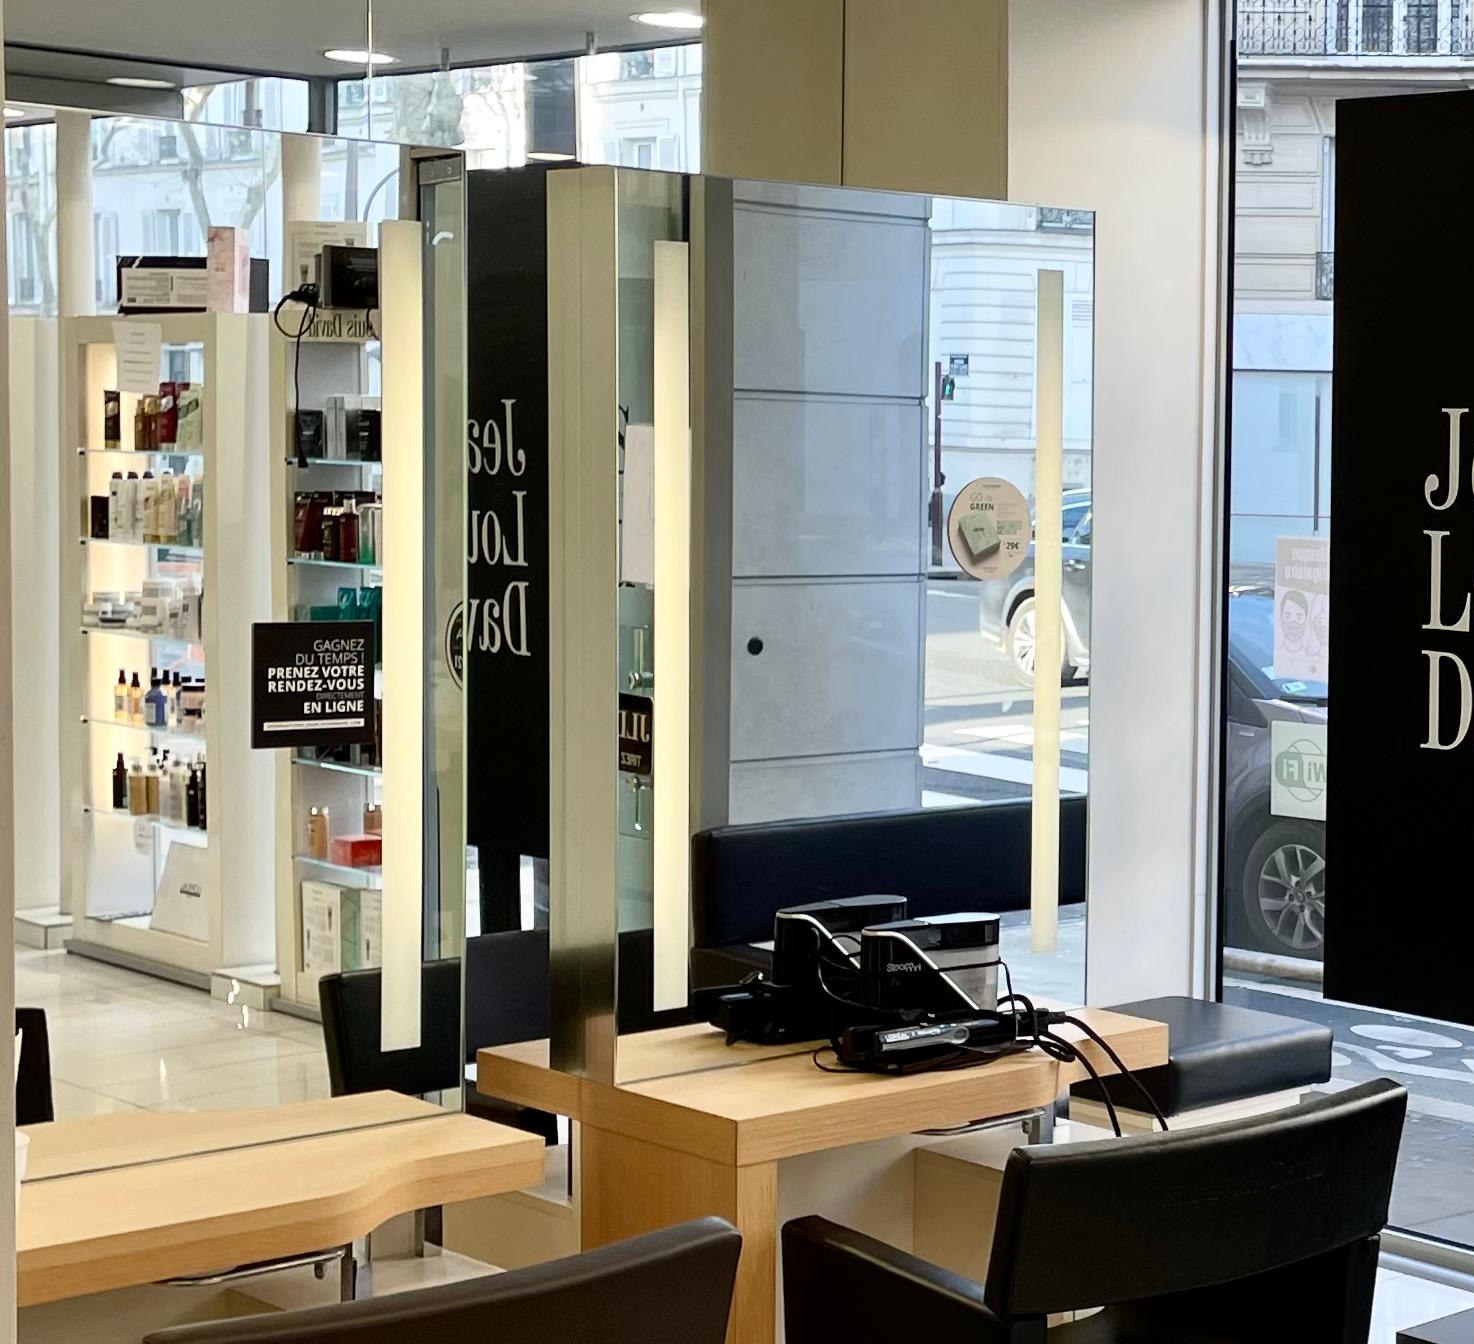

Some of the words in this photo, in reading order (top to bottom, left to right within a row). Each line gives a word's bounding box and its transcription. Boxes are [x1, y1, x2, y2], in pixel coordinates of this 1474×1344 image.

[313, 638, 365, 652] GAGNEZ
[295, 653, 314, 666] DU
[318, 652, 358, 665] TEMPS
[267, 666, 319, 679] PRENEZ
[321, 665, 364, 677] VOTRE
[267, 678, 364, 693] RENDEZ-VOUS
[303, 702, 321, 714] EN
[325, 700, 364, 713] LIGNE
